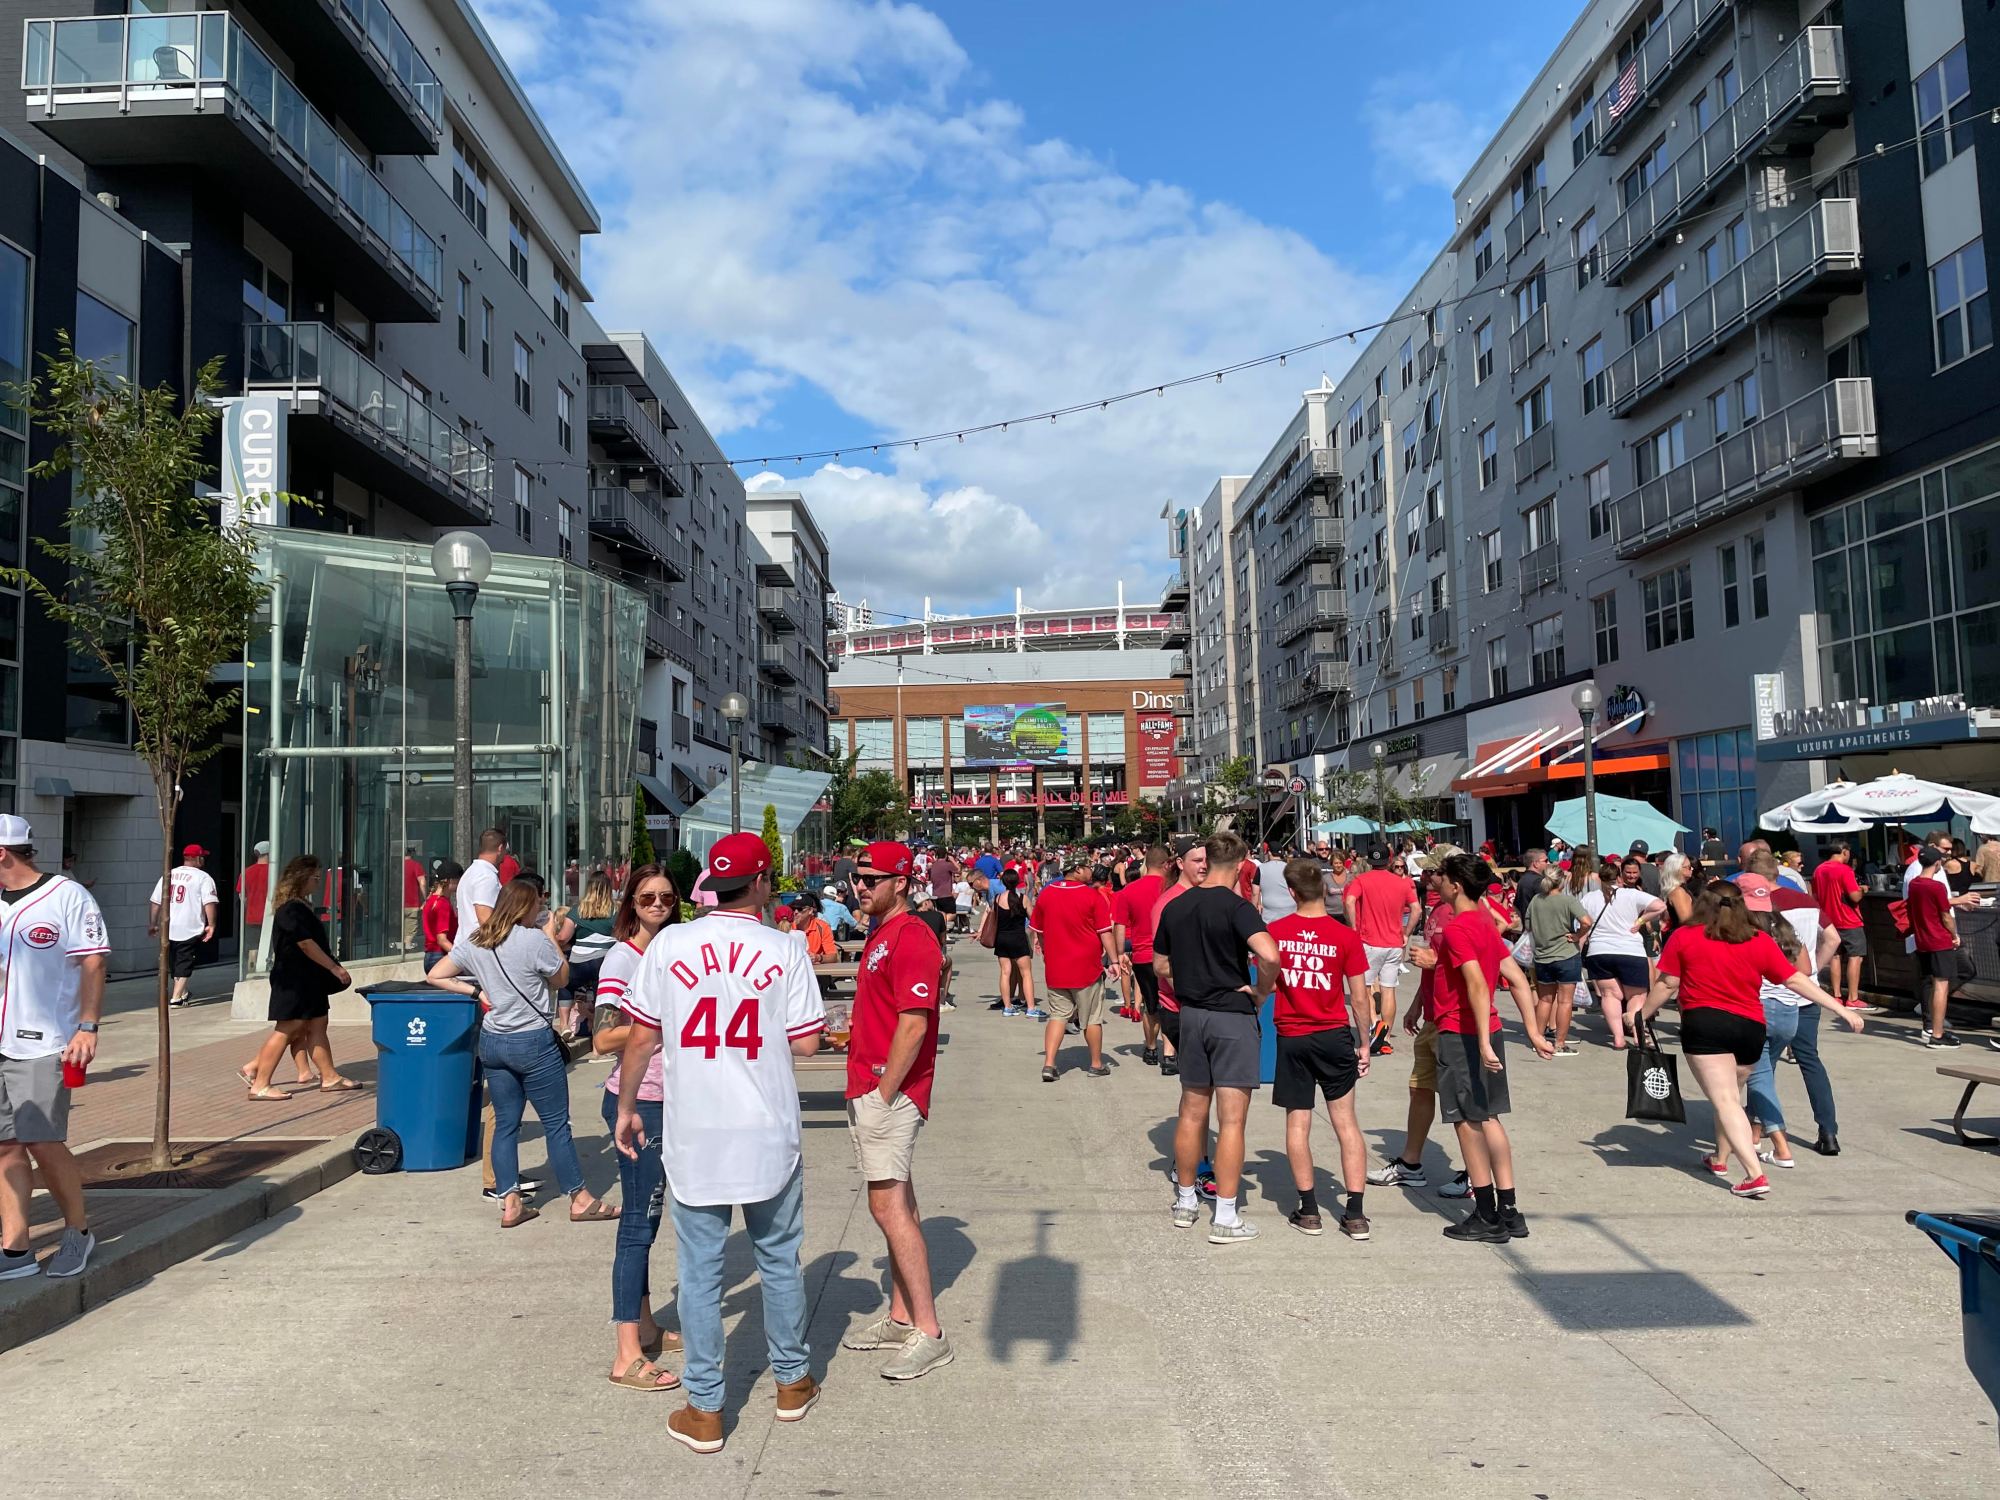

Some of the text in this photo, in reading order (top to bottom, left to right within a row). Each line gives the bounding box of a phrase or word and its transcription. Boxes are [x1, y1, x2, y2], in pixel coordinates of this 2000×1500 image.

[1140, 721, 1174, 731] HALL FAME
[1797, 729, 1911, 753] LUXURY APARTMENTS
[910, 794, 986, 806] CNCNNATI
[1030, 792, 1067, 804] HALL
[1070, 792, 1087, 803] OF
[29, 931, 59, 941] REDS
[1278, 940, 1337, 957] PREPARE
[669, 942, 784, 991] DAVIS
[1289, 954, 1324, 971] TO
[1281, 968, 1333, 991] WIN
[680, 997, 763, 1060] 44
